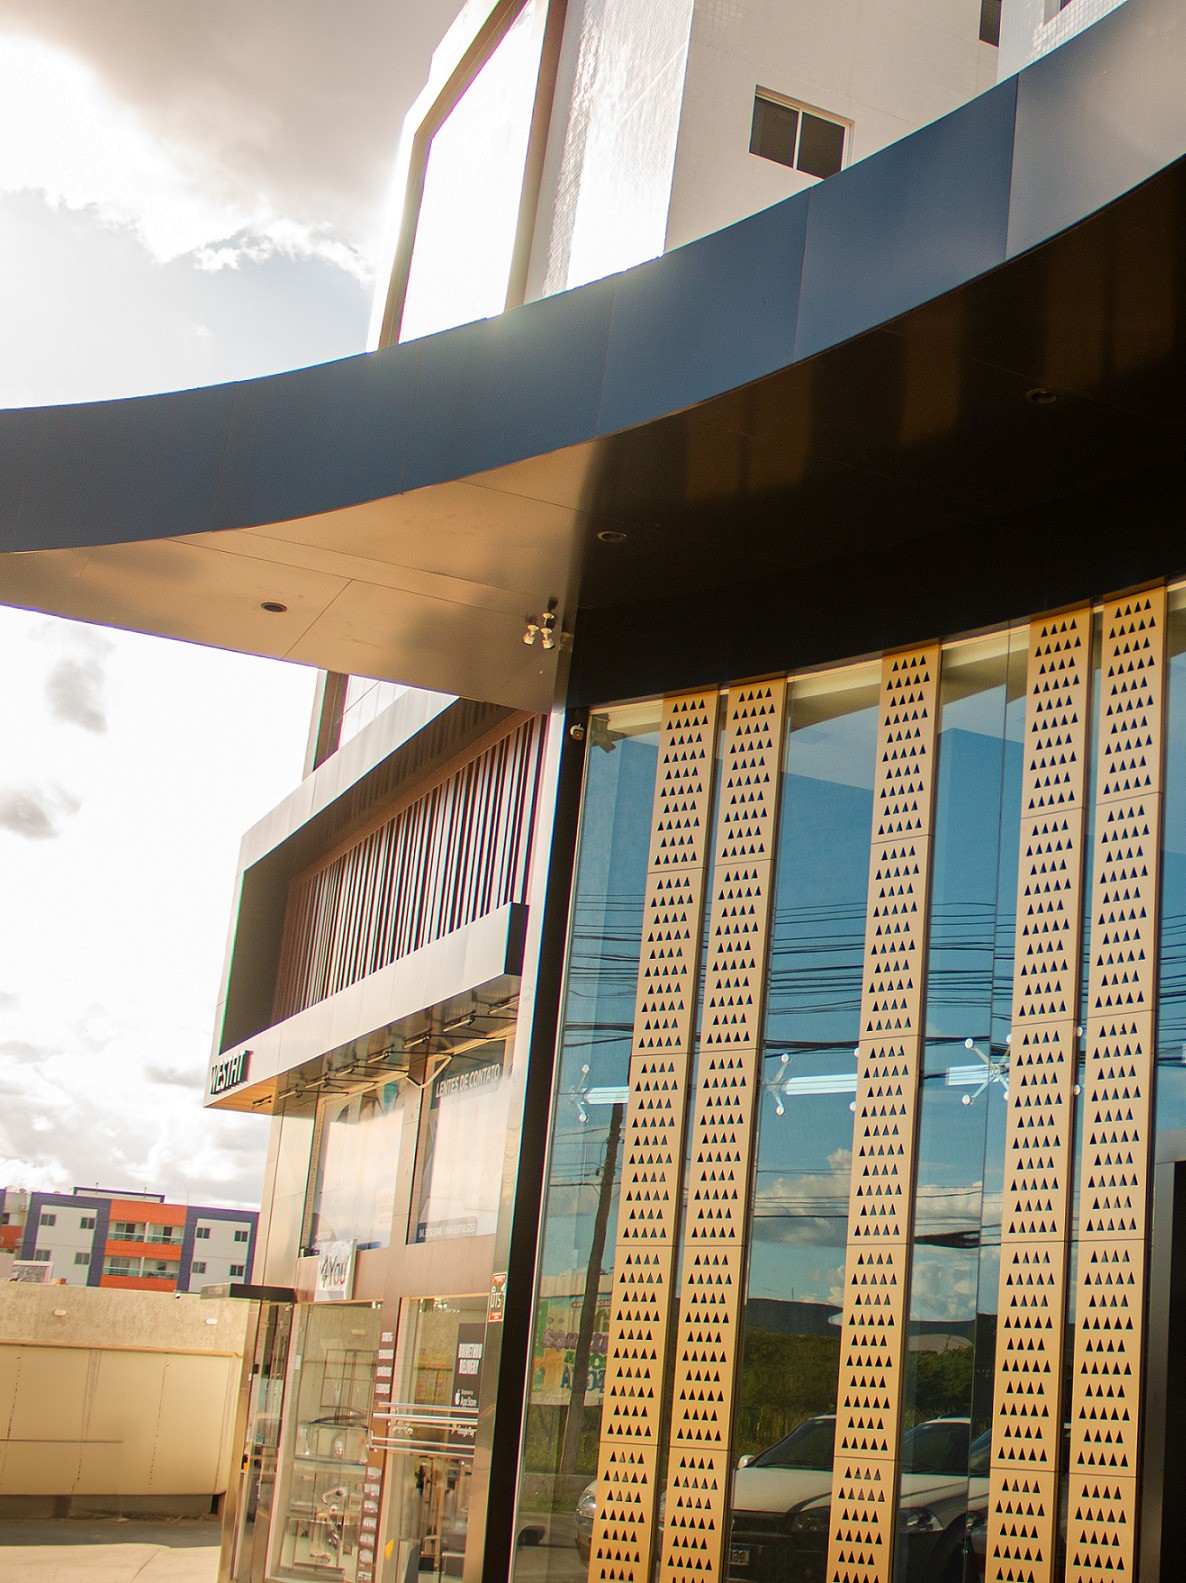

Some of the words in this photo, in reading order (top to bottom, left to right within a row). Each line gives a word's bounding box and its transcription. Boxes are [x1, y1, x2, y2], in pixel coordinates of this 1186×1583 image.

[435, 1076, 459, 1099] LENTES
[459, 1072, 469, 1091] DE
[469, 1063, 501, 1089] CONTATO
